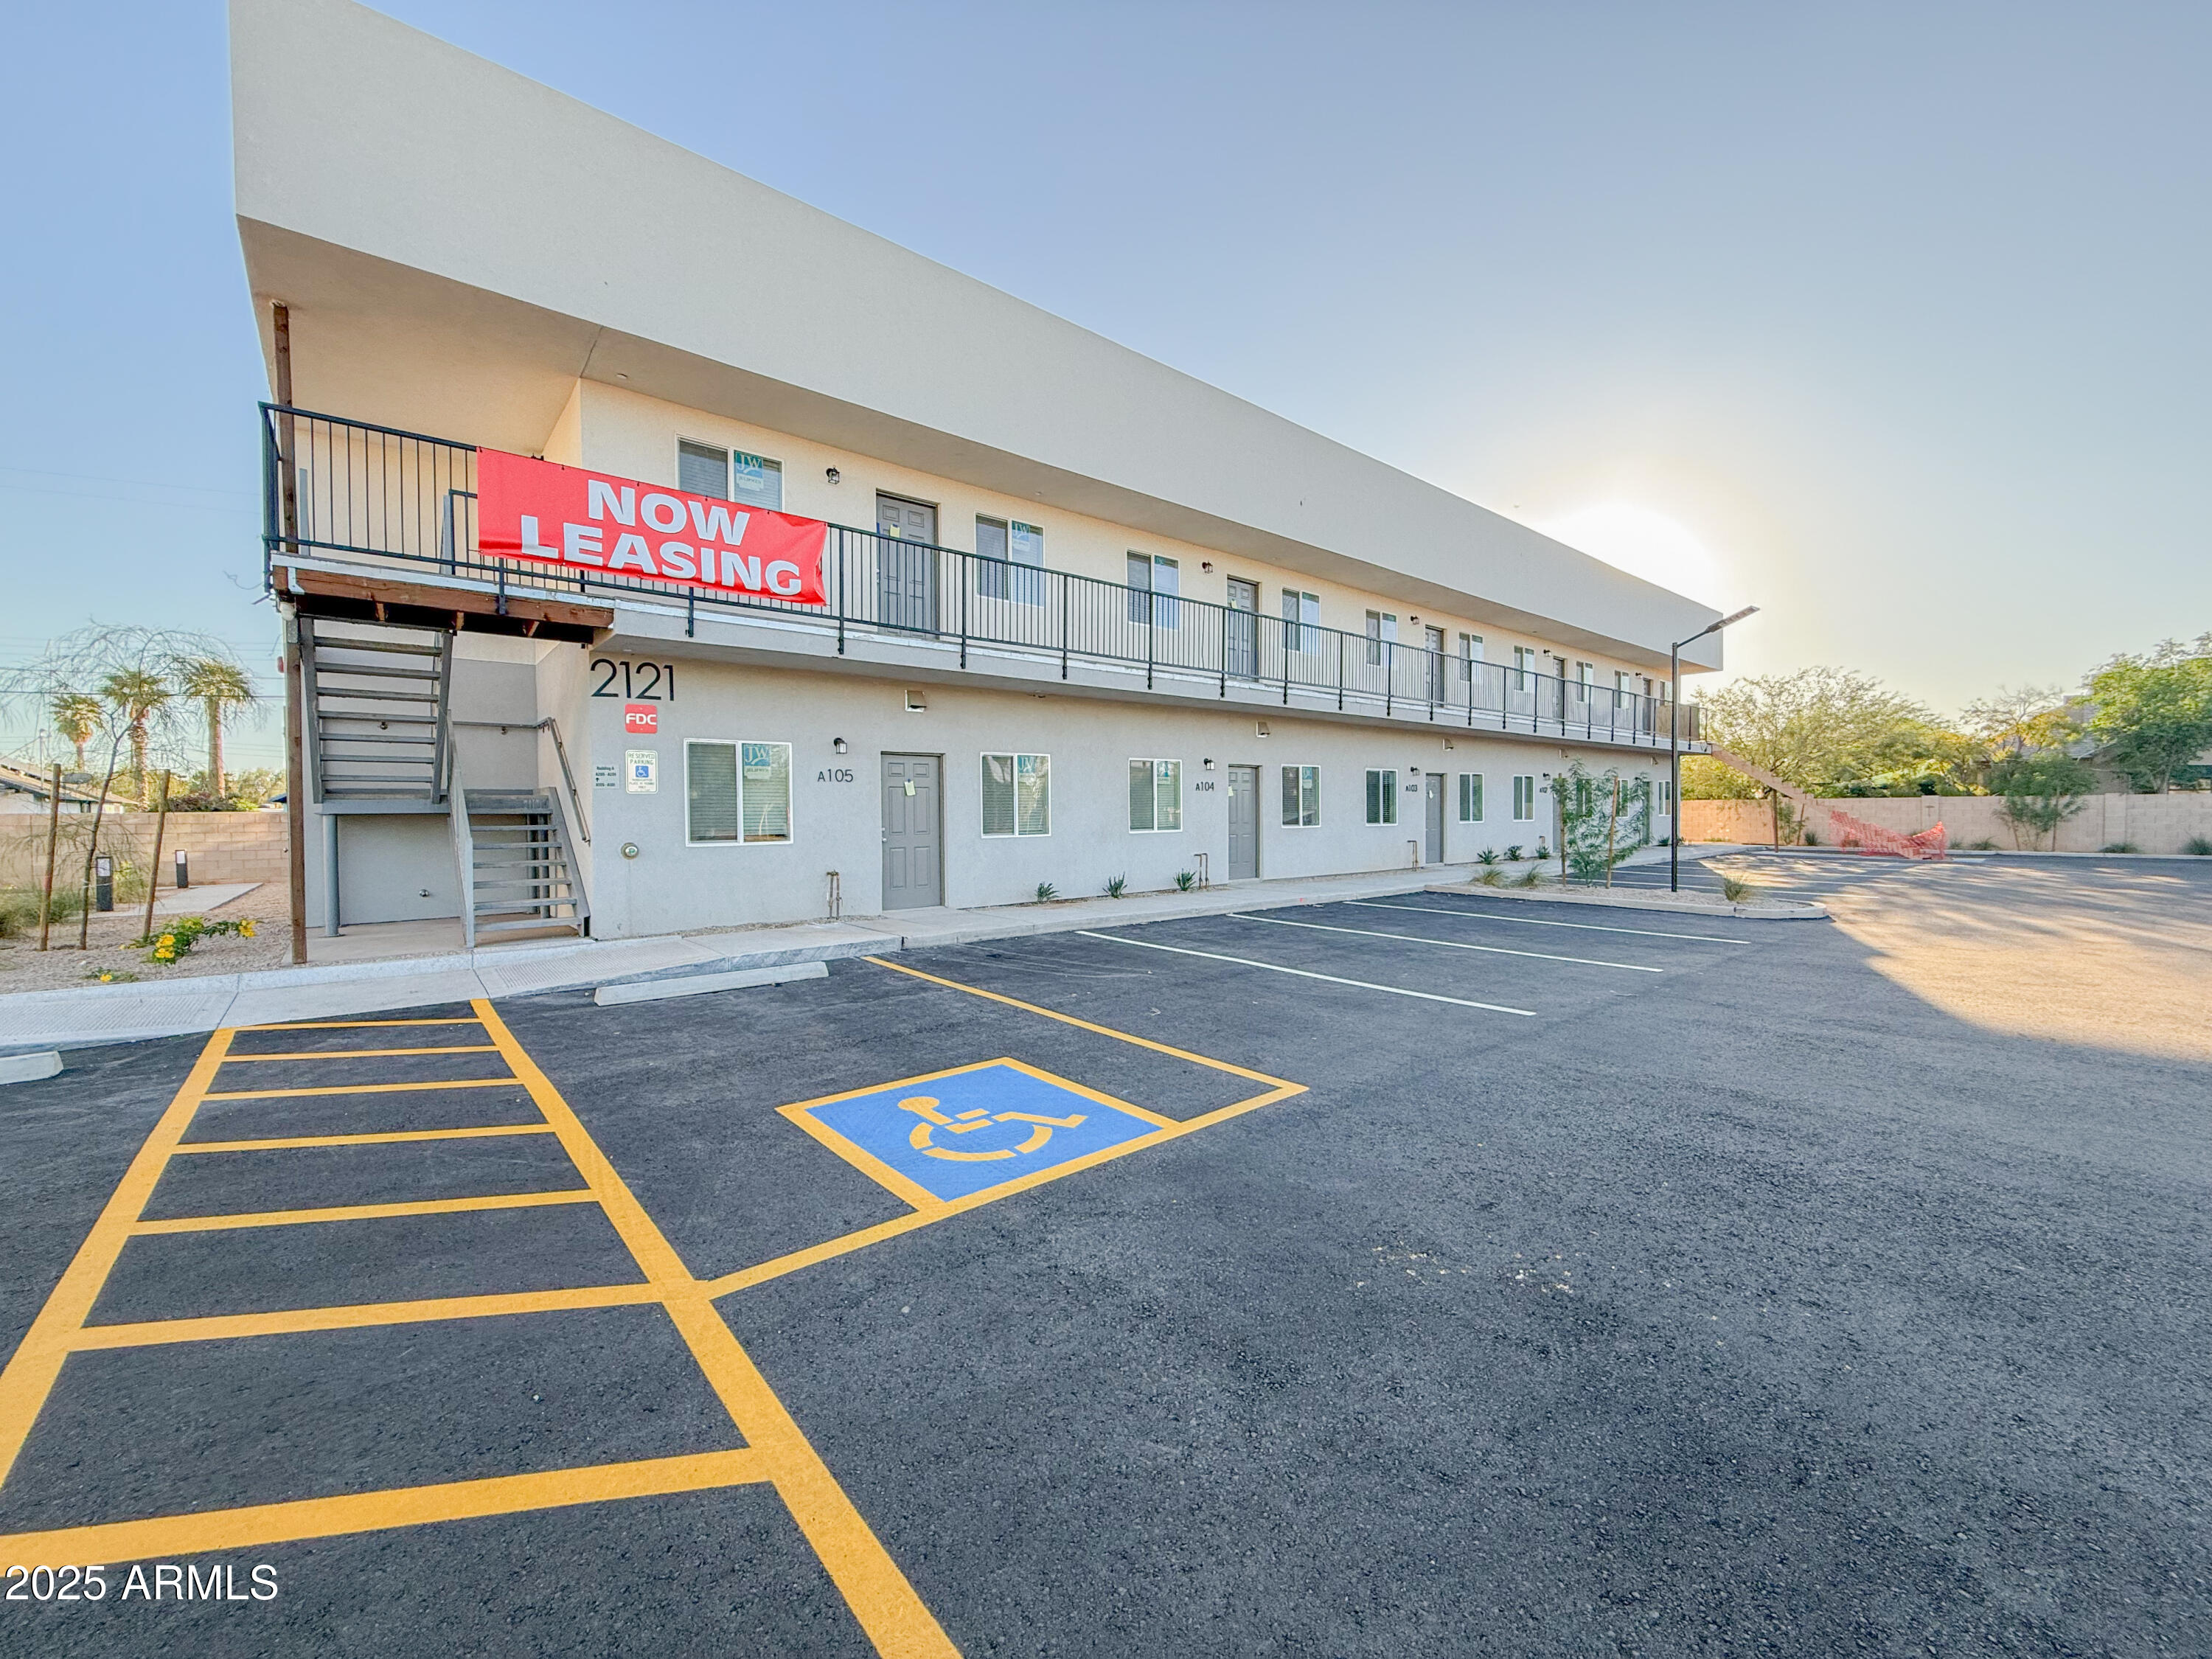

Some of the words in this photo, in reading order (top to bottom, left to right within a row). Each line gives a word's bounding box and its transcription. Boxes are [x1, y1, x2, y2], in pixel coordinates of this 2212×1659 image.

[737, 454, 762, 470] JW
[588, 479, 751, 546] NOW
[521, 515, 802, 596] LEASING
[591, 658, 674, 701] 2121
[625, 712, 657, 726] FDC
[745, 746, 768, 762] JW
[818, 768, 853, 782] A105
[1195, 782, 1214, 791] A104
[1405, 784, 1418, 792] A103
